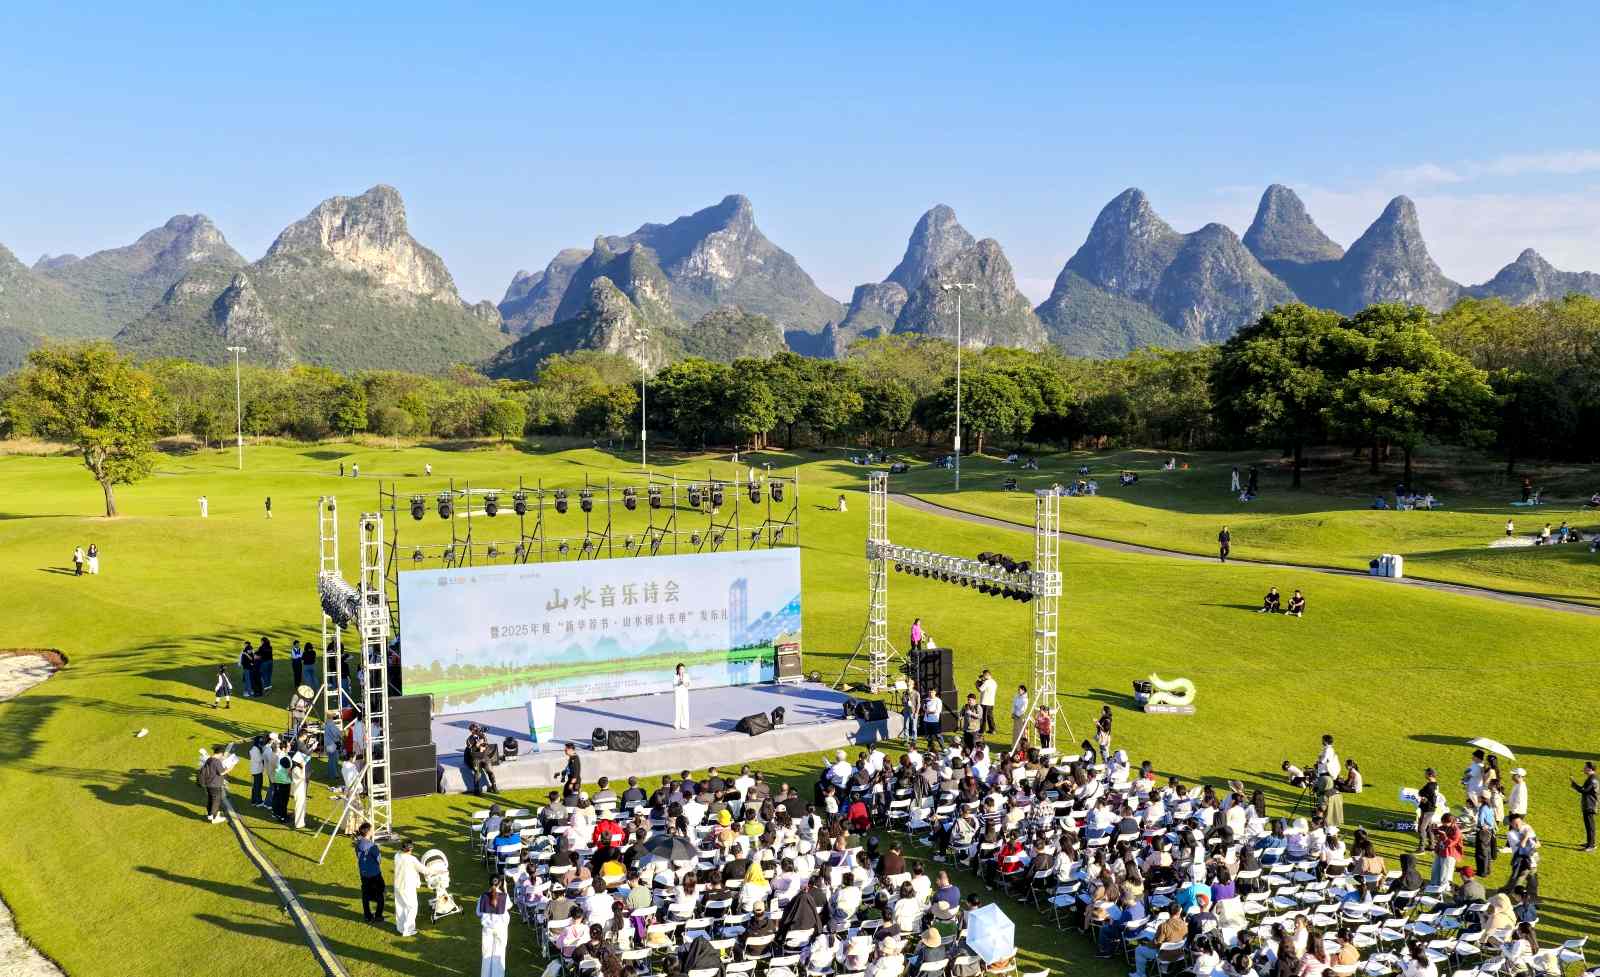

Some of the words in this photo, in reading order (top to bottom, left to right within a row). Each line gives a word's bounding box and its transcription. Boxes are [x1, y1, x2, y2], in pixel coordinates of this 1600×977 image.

[545, 580, 680, 611] 山水音乐诗会
